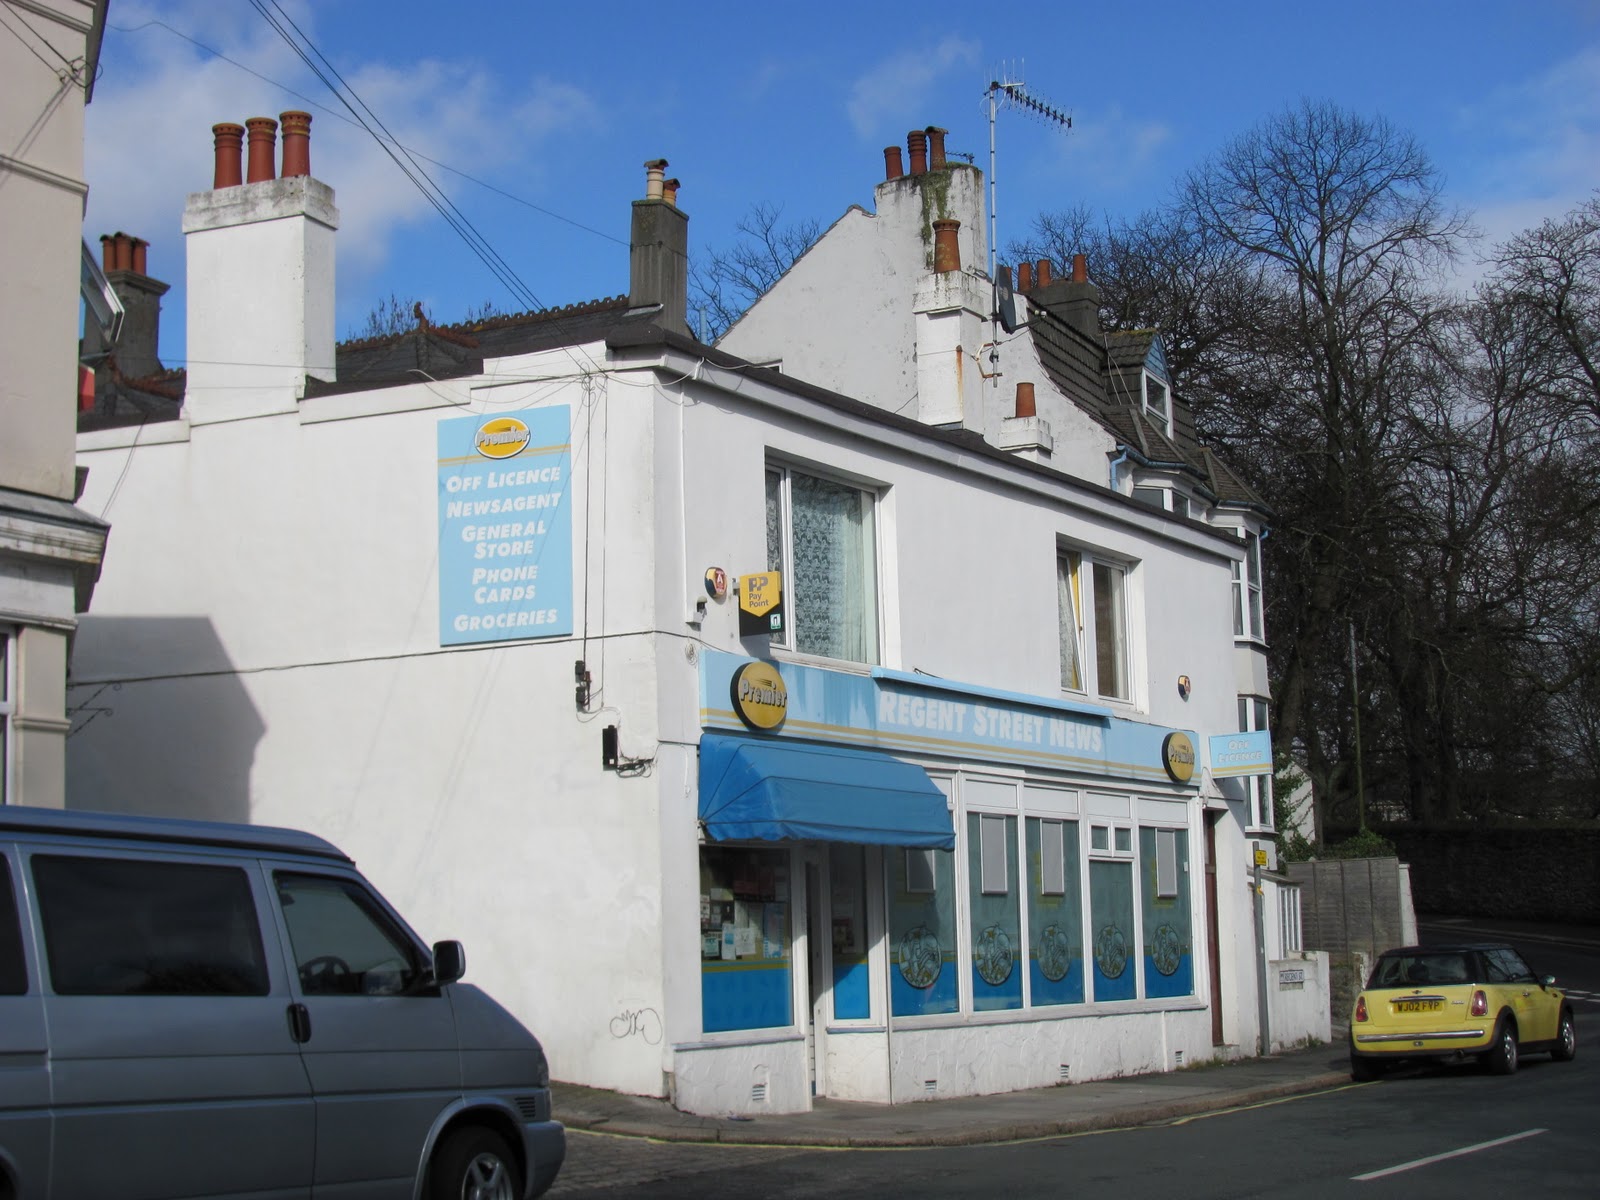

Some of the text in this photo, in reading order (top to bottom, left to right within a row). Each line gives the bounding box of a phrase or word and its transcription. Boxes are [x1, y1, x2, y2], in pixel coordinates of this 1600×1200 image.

[475, 427, 530, 447] Premier
[446, 466, 561, 492] OFF LICENCE
[447, 492, 562, 518] NEWSAGENT
[461, 520, 546, 542] GENERAL
[474, 539, 534, 560] STORE
[472, 565, 538, 585] PHONE
[474, 585, 536, 605] CARDS
[749, 593, 762, 602] Pay
[749, 600, 769, 608] Point
[453, 608, 558, 632] GROCERIES
[741, 679, 787, 708] Premier
[879, 691, 1103, 753] REGENT STREET NEWS
[1169, 744, 1195, 766] Premier
[1228, 740, 1249, 750] OFF
[1217, 751, 1264, 763] LICENCE
